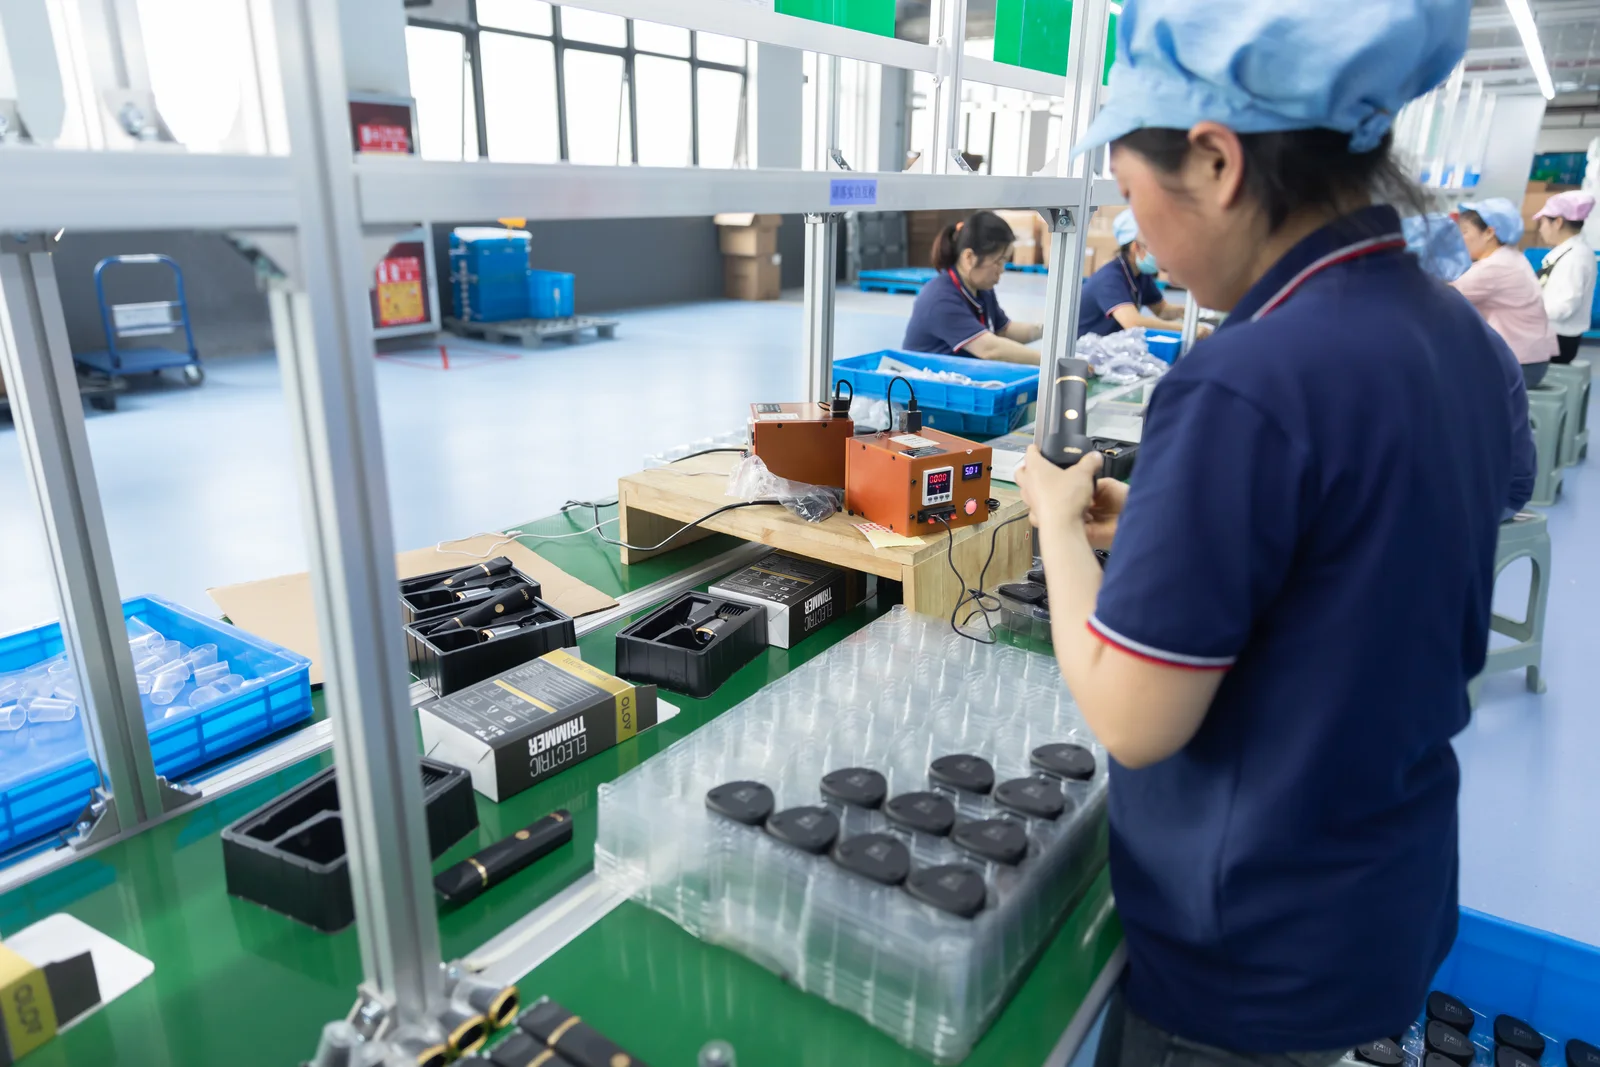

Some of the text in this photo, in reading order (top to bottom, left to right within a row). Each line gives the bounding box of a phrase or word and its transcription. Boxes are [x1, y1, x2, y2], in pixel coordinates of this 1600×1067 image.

[804, 586, 832, 615] TRIMMER
[804, 601, 832, 632] ELECTRIC
[528, 715, 587, 756] TRIMMER
[529, 734, 587, 778] ELECTRIC
